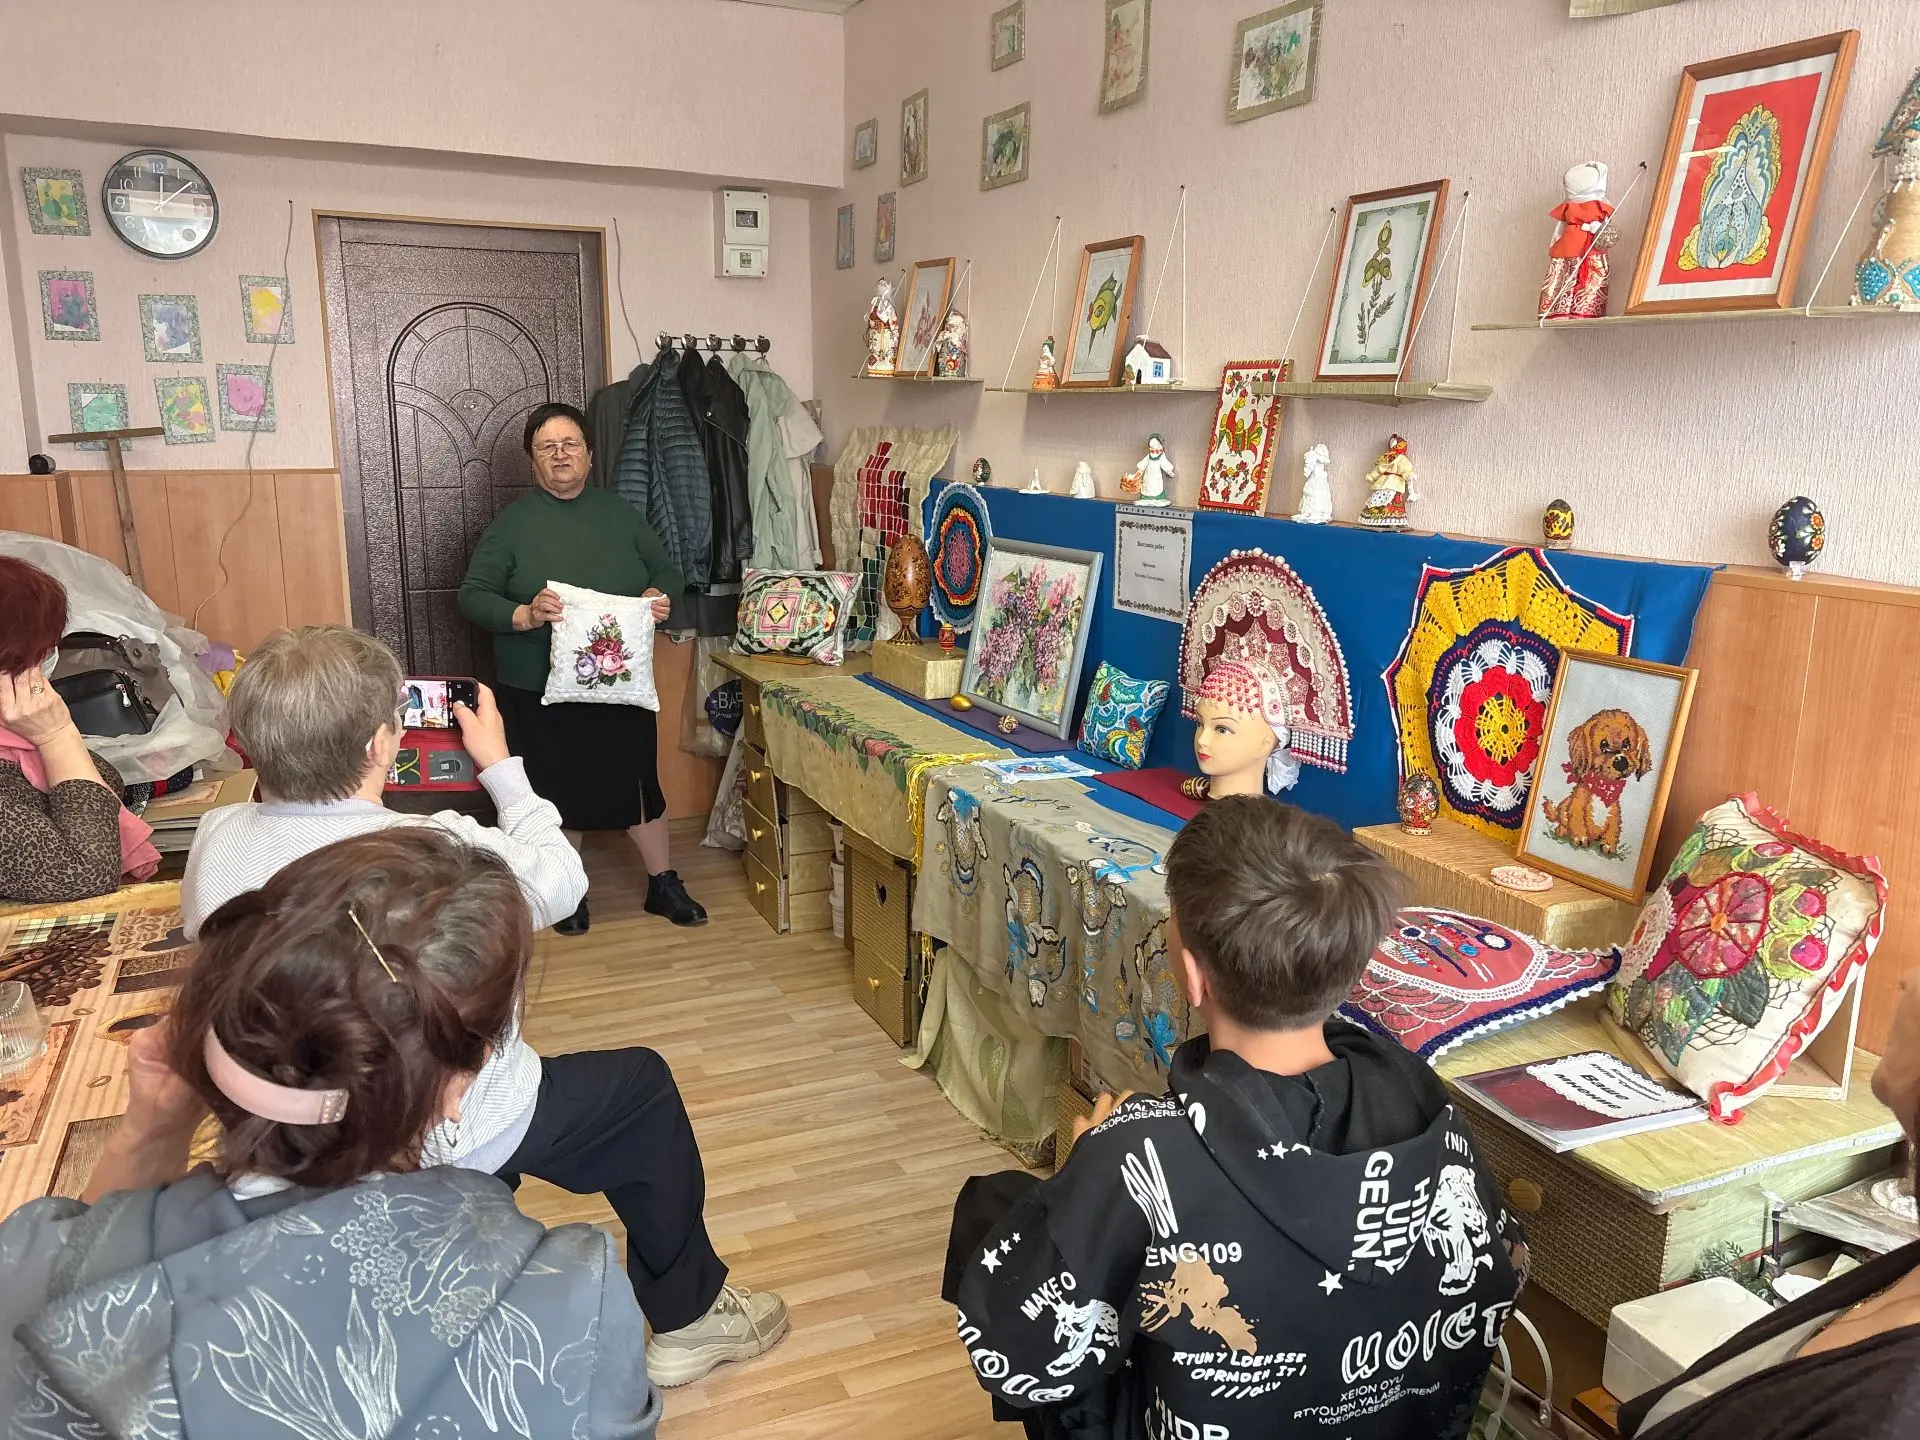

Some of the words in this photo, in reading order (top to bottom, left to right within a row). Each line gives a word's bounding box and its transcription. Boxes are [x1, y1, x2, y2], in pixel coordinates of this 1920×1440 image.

[133, 166, 142, 178] 11
[152, 162, 165, 174] 12
[119, 178, 134, 191] 10
[115, 196, 126, 209] 9
[124, 215, 135, 229] 8
[1553, 1073, 1622, 1109] мнение
[1580, 1074, 1629, 1100] Ваше
[1145, 1240, 1242, 1267] ENG109
[1020, 1276, 1063, 1321] MAKE
[1340, 1383, 1377, 1402] XEION
[1293, 1400, 1356, 1420] RTYOURN
